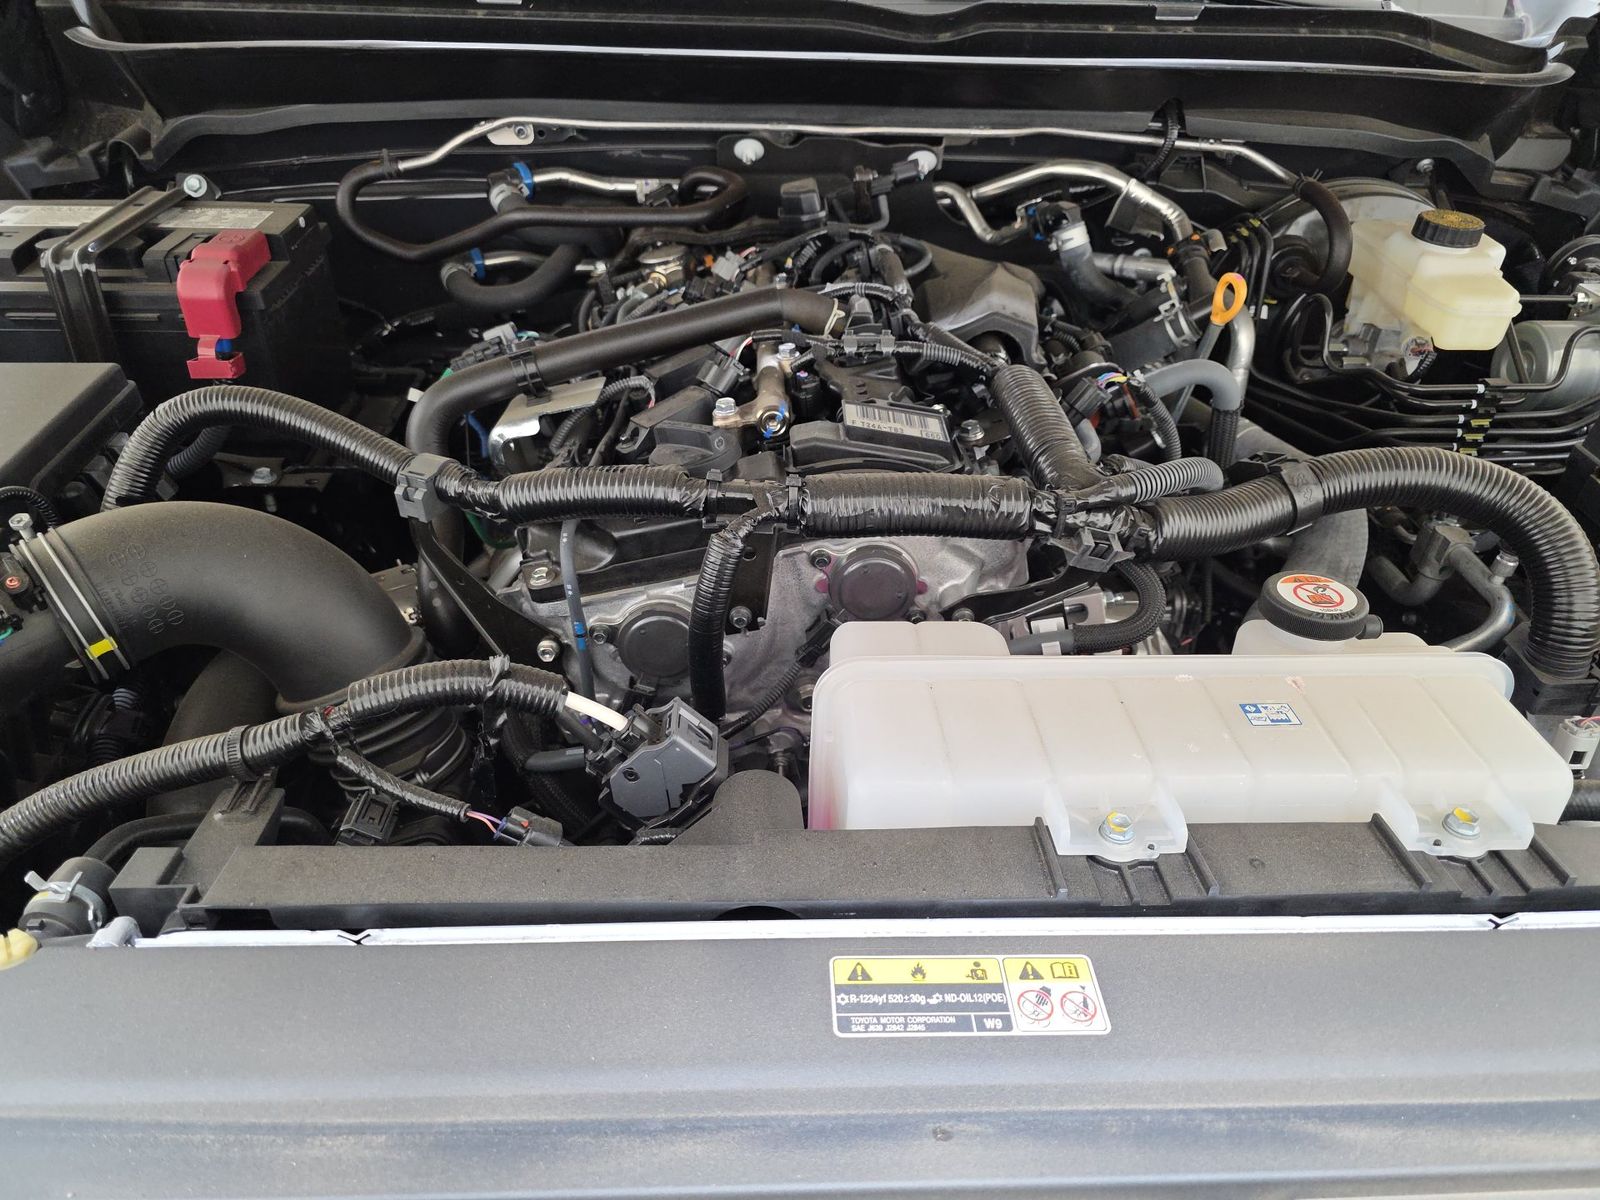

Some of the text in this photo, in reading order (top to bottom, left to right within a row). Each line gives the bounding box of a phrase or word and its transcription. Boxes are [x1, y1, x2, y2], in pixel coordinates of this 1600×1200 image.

[849, 993, 887, 1006] R-1234yf
[944, 993, 1007, 1005] ND-OIL12(POE)
[850, 1016, 956, 1024] TOYOTA MOTOR CORPORATION
[983, 1018, 1003, 1030] W9
[851, 1024, 866, 1032] SAE
